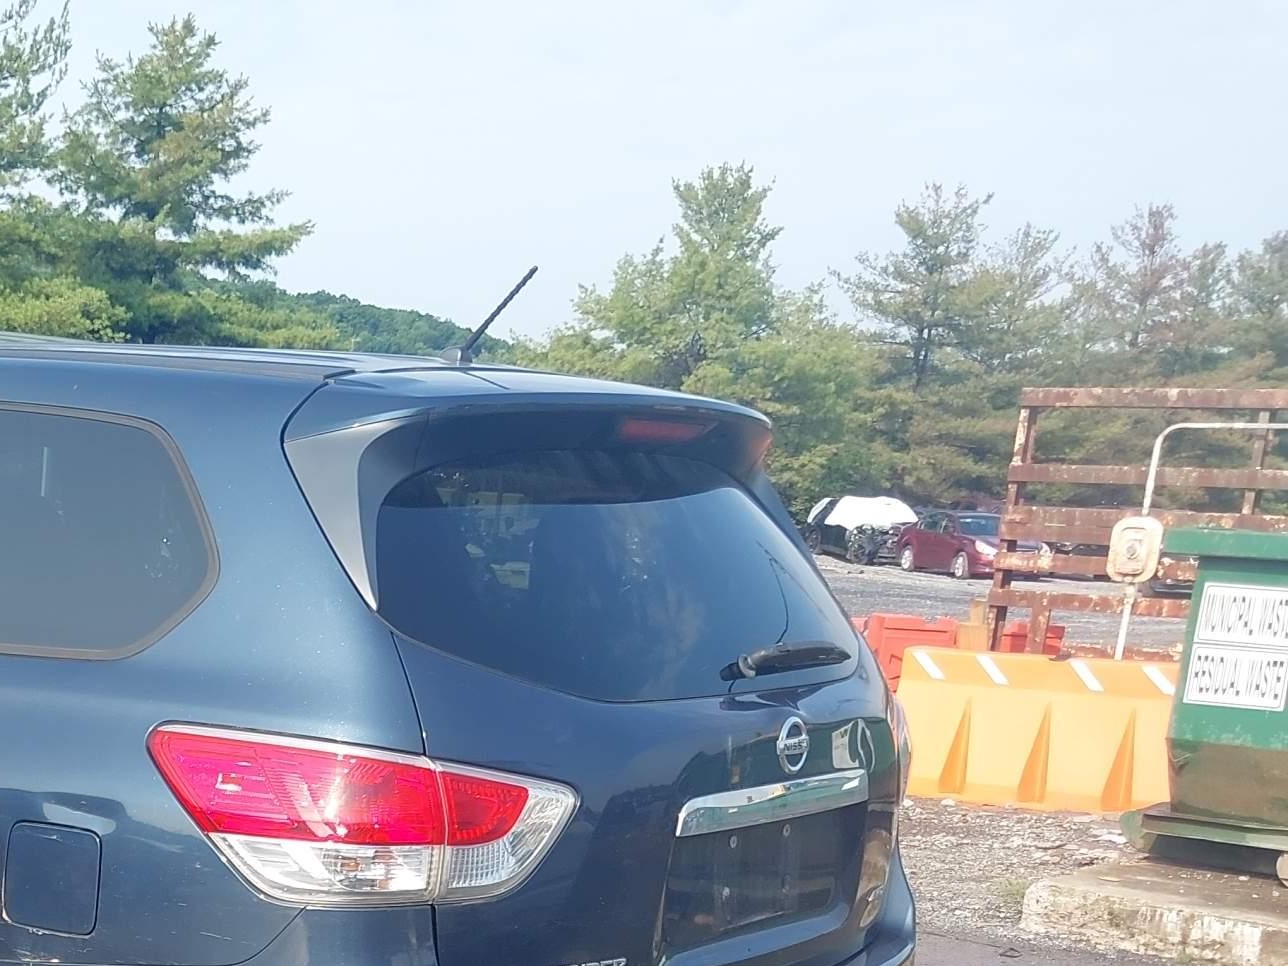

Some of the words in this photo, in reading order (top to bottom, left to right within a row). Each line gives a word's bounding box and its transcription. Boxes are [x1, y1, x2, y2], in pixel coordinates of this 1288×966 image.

[1203, 594, 1256, 637] MUNICIPAL
[1193, 655, 1241, 697] RESIDUAL
[1244, 659, 1285, 700] WASTE
